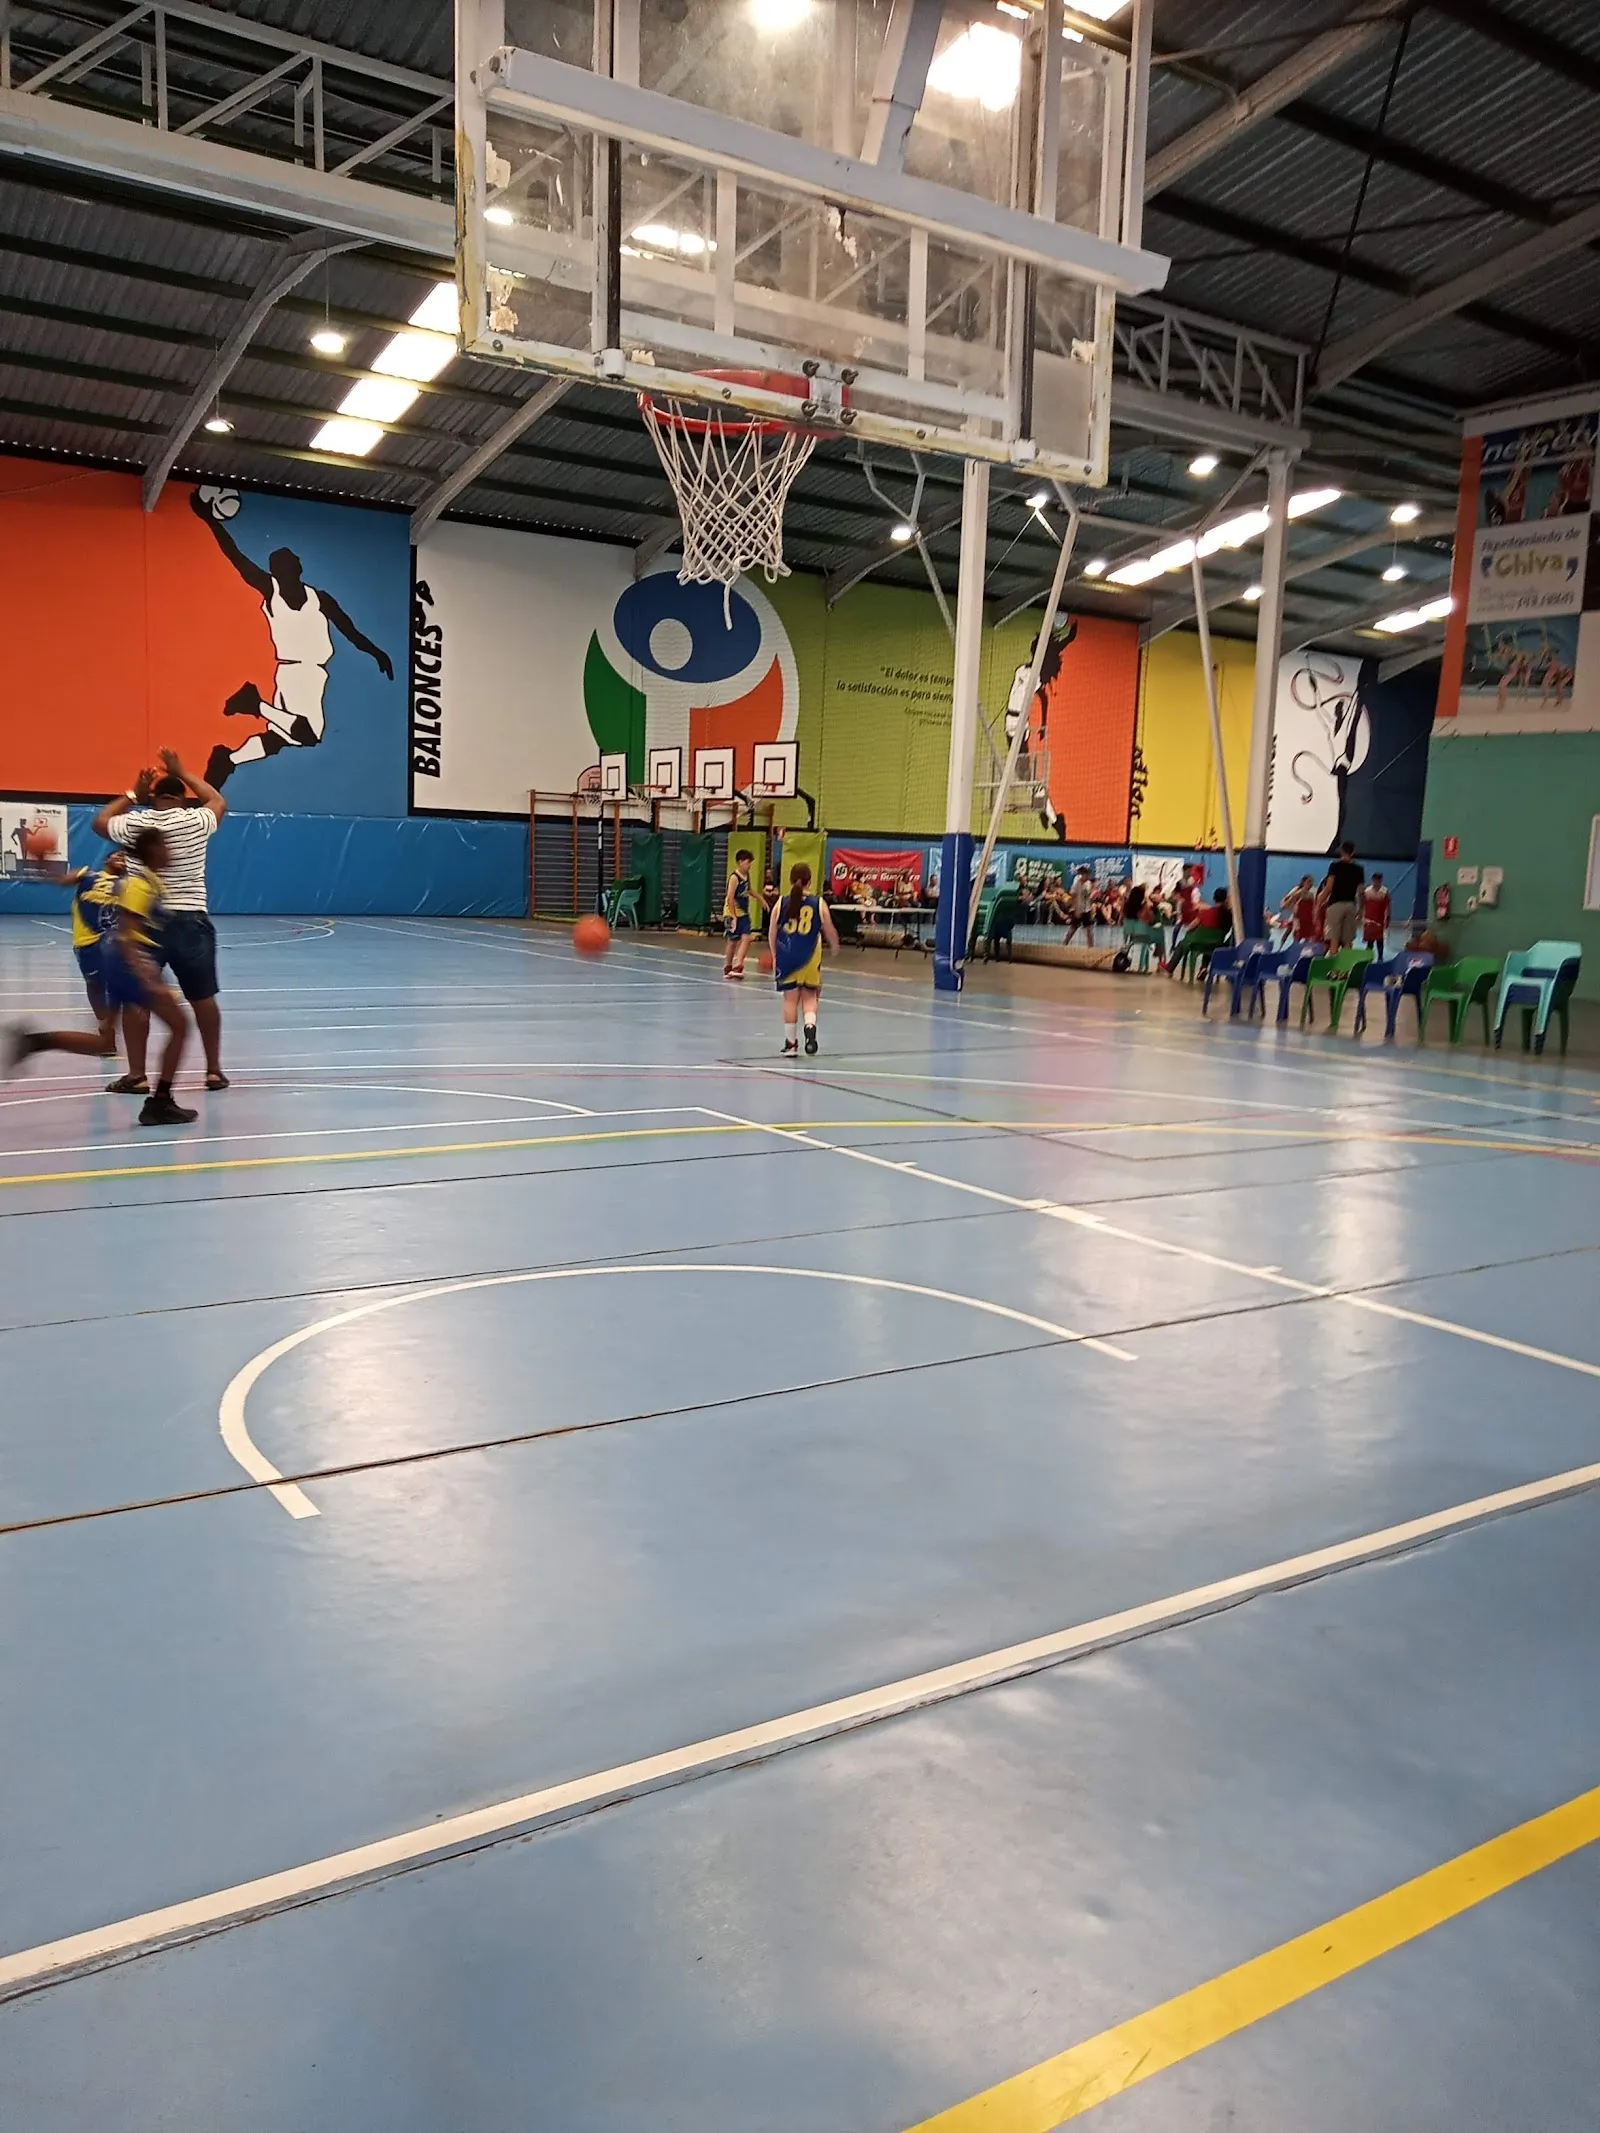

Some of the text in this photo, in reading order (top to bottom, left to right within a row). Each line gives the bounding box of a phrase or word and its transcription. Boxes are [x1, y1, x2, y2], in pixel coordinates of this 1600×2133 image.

[895, 668, 918, 681] dolor
[836, 680, 846, 690] la
[900, 688, 910, 698] es
[911, 689, 931, 701] para
